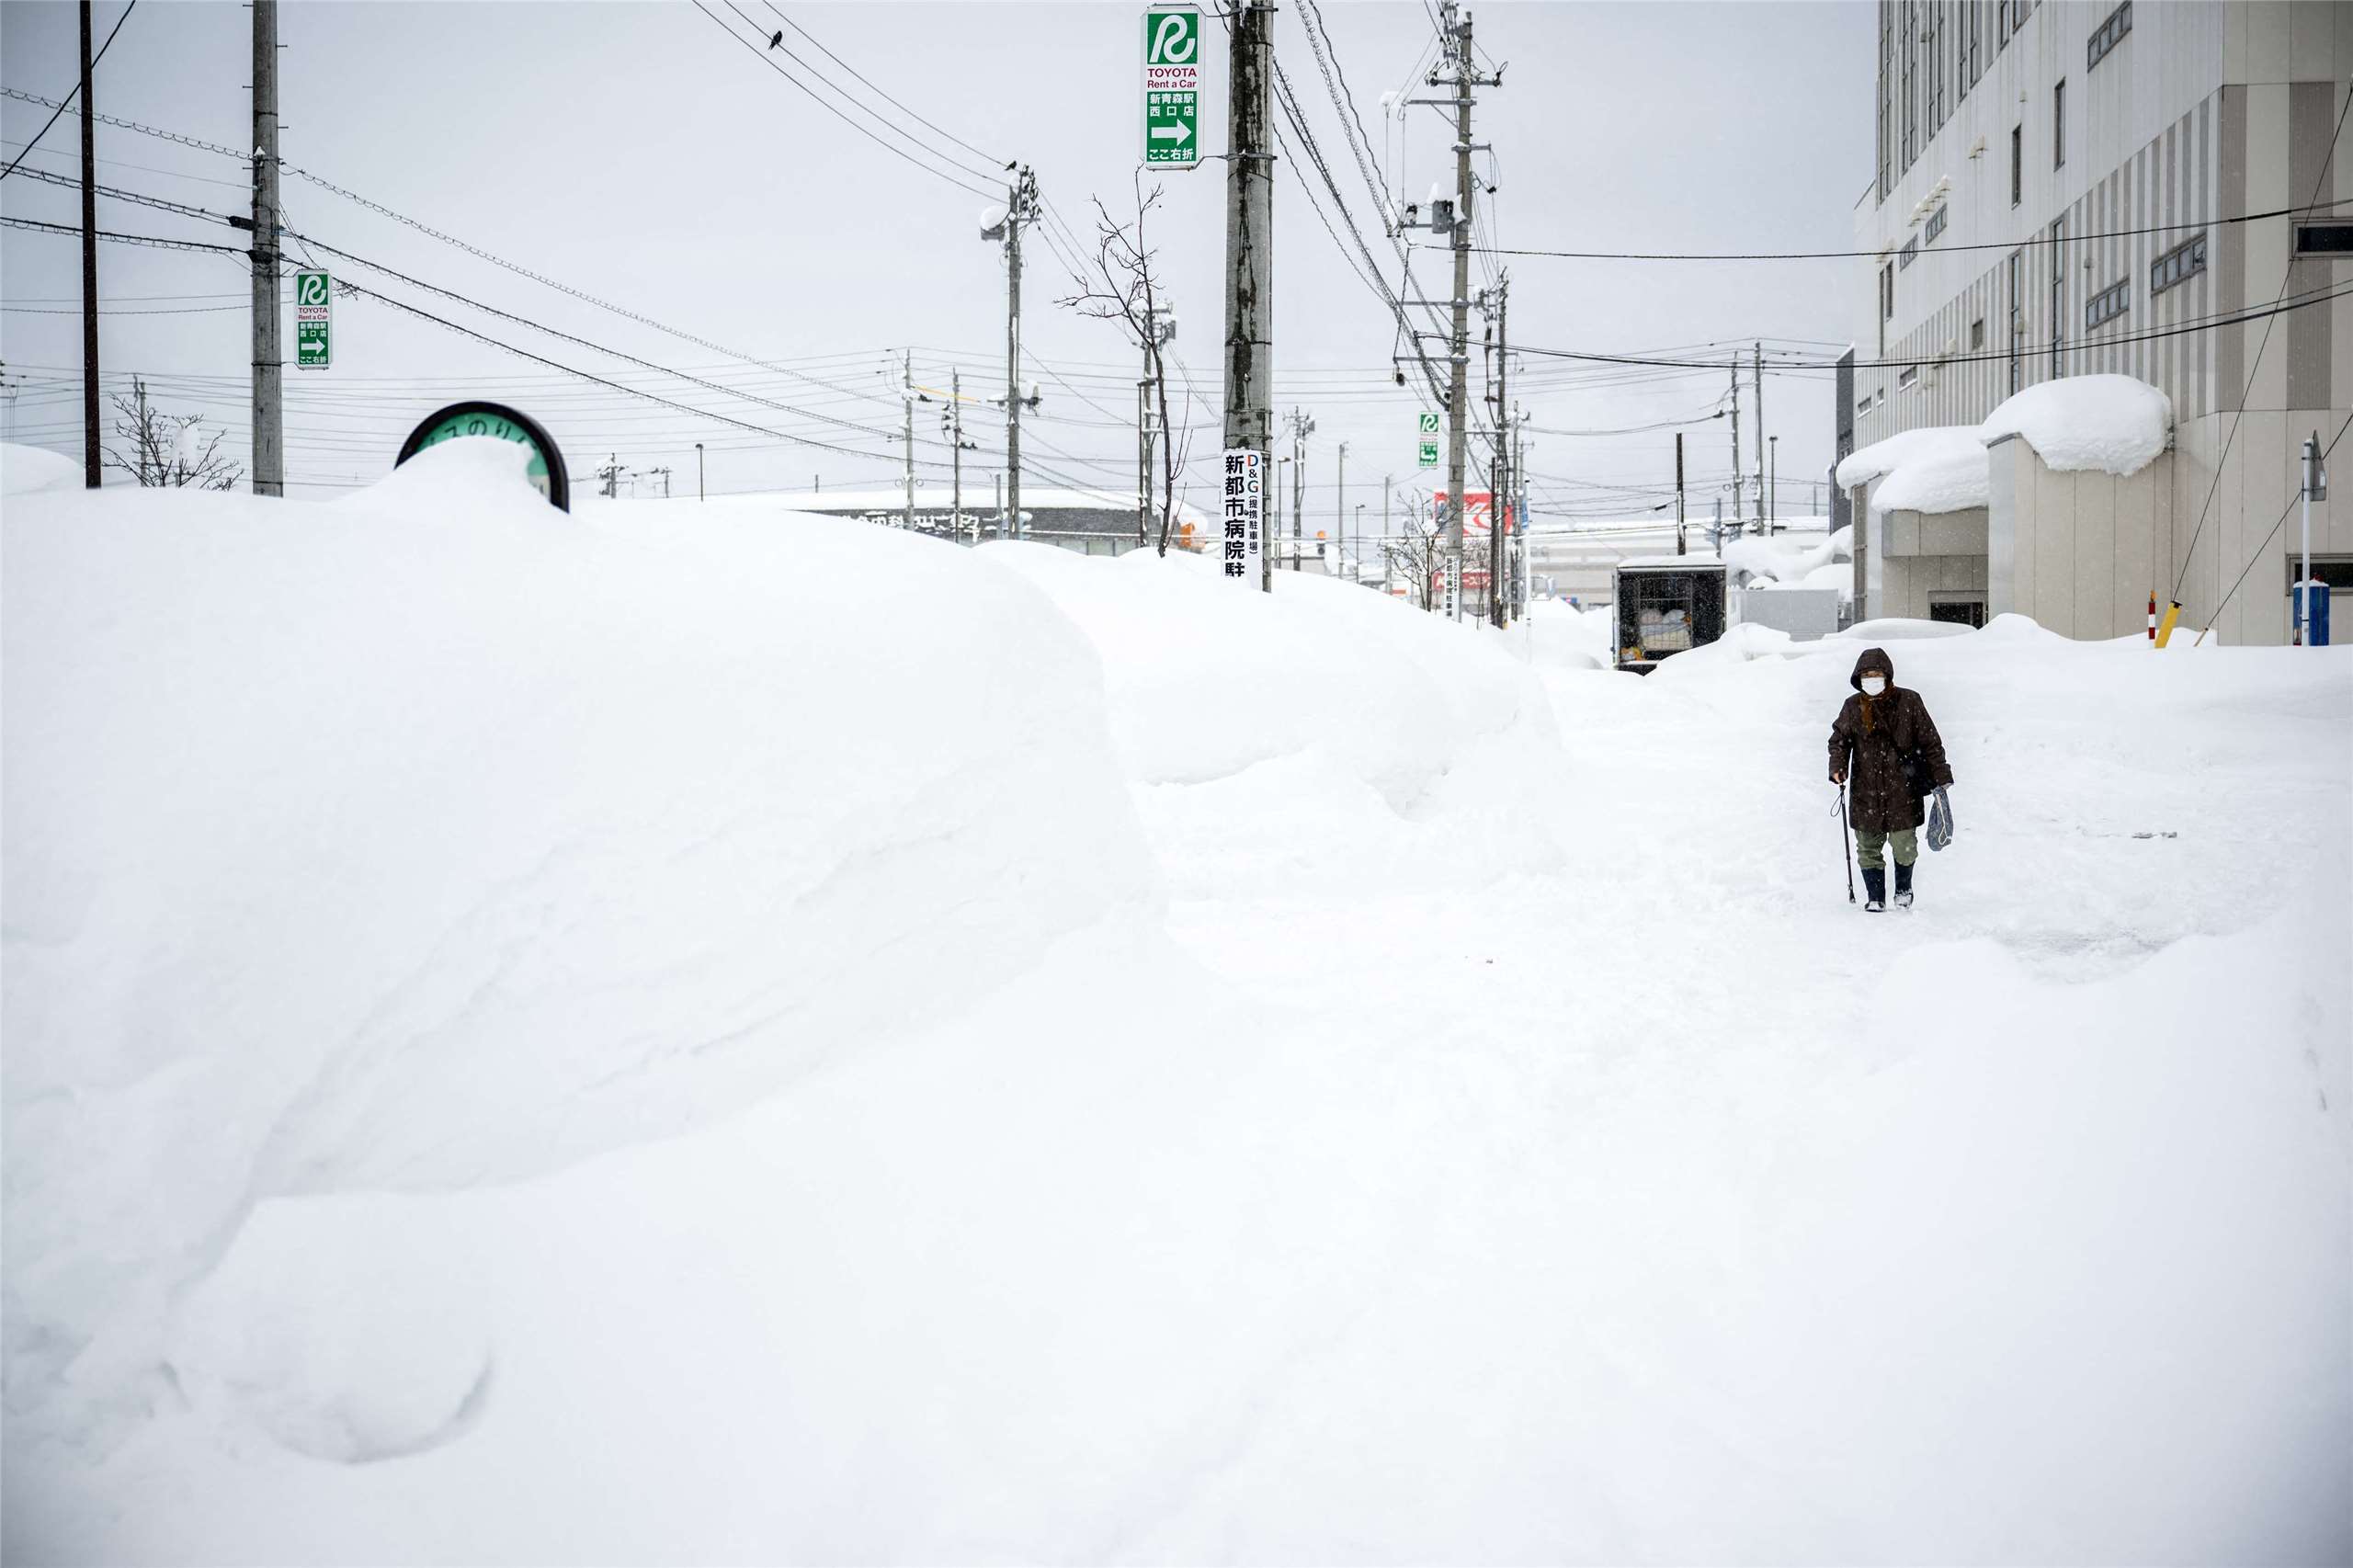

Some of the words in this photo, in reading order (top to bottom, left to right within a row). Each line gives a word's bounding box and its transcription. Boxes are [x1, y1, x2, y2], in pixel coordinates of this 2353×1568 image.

[1147, 68, 1197, 78] TOYOTA
[1147, 80, 1169, 88] Rent
[1179, 80, 1197, 88] Car
[1150, 93, 1194, 104] 新青森駅
[1149, 148, 1194, 160] ここ右折
